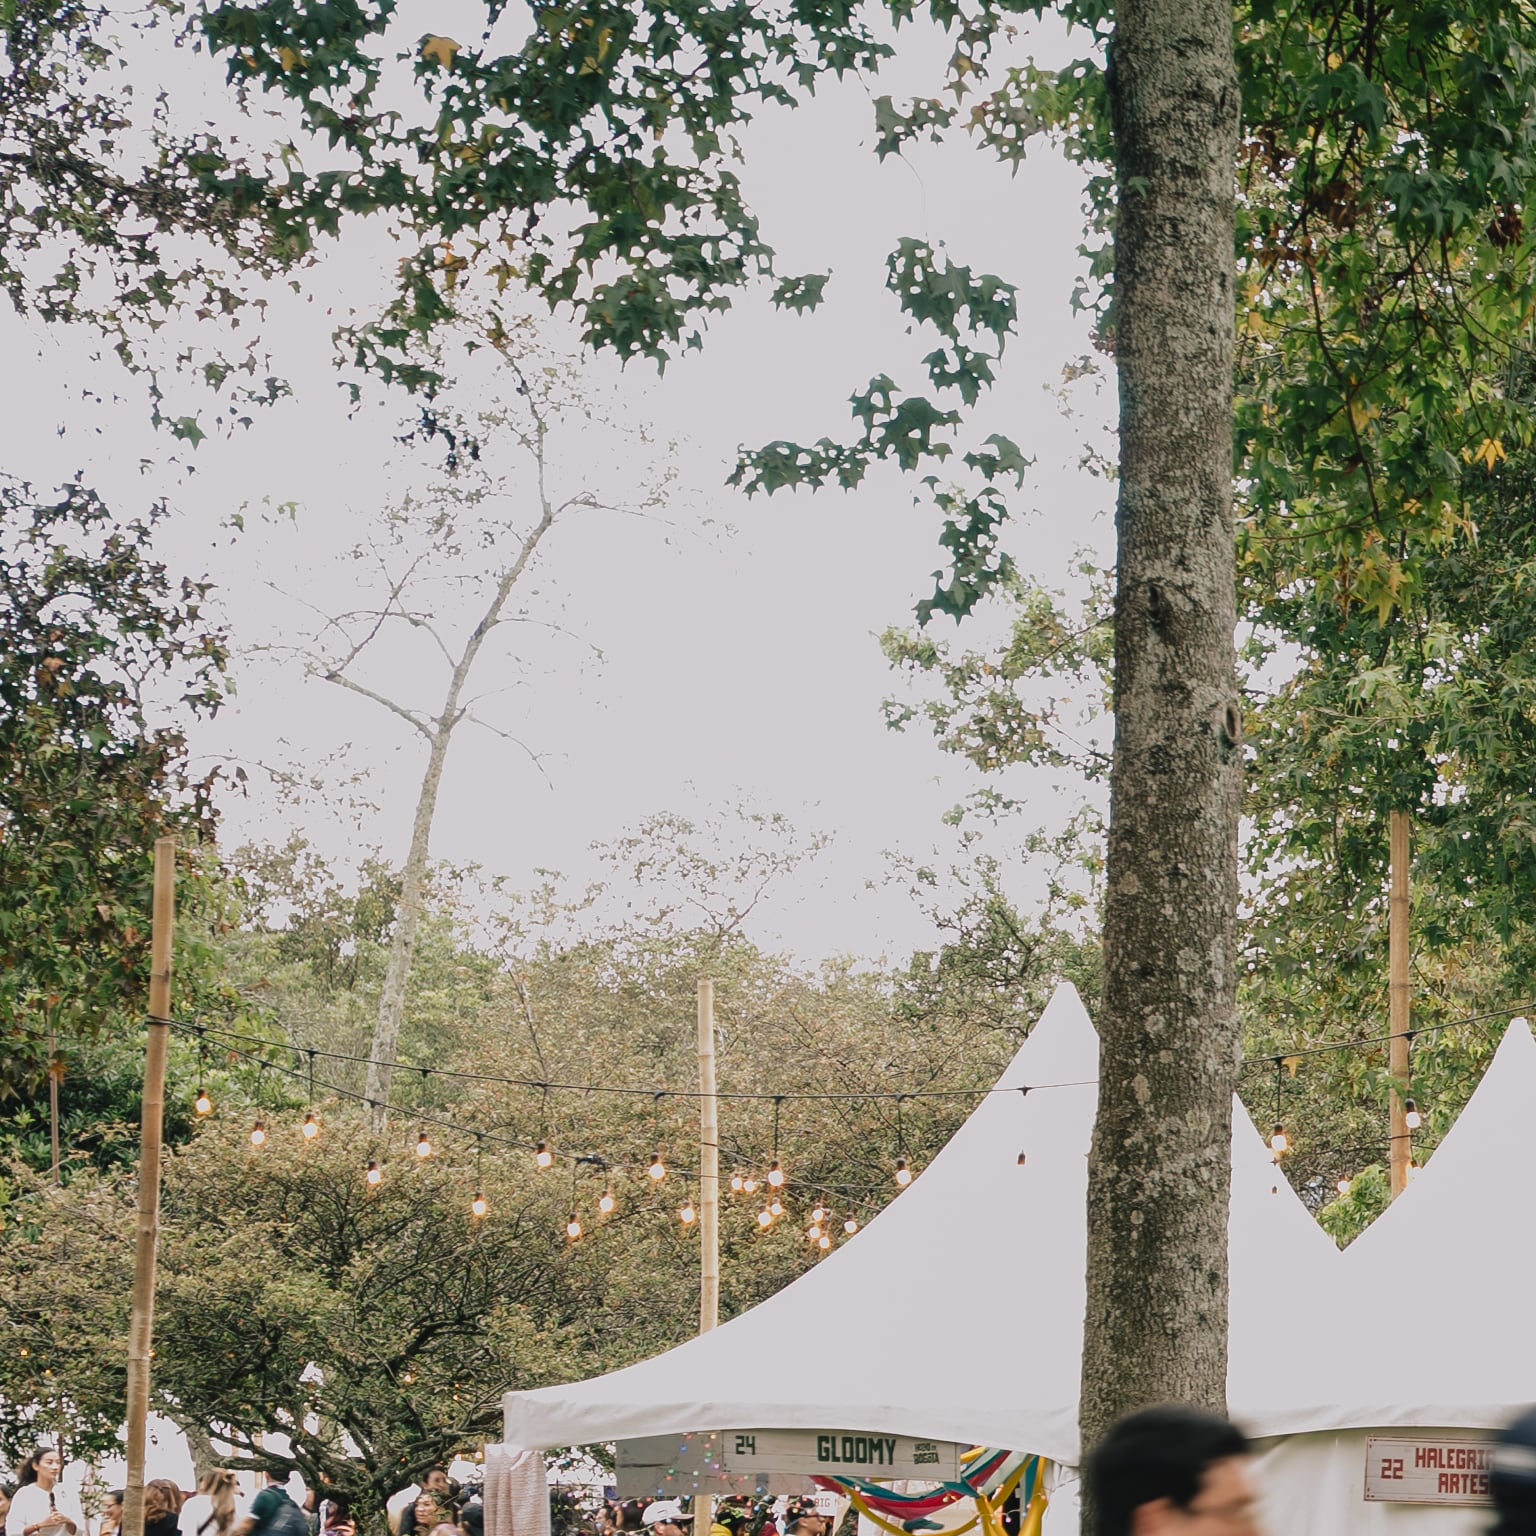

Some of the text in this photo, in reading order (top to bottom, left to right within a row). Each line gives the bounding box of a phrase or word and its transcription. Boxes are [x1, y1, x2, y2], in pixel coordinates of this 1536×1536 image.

[735, 1435, 756, 1455] 24
[817, 1435, 896, 1465] GLOOMY
[1381, 1459, 1404, 1479] 22
